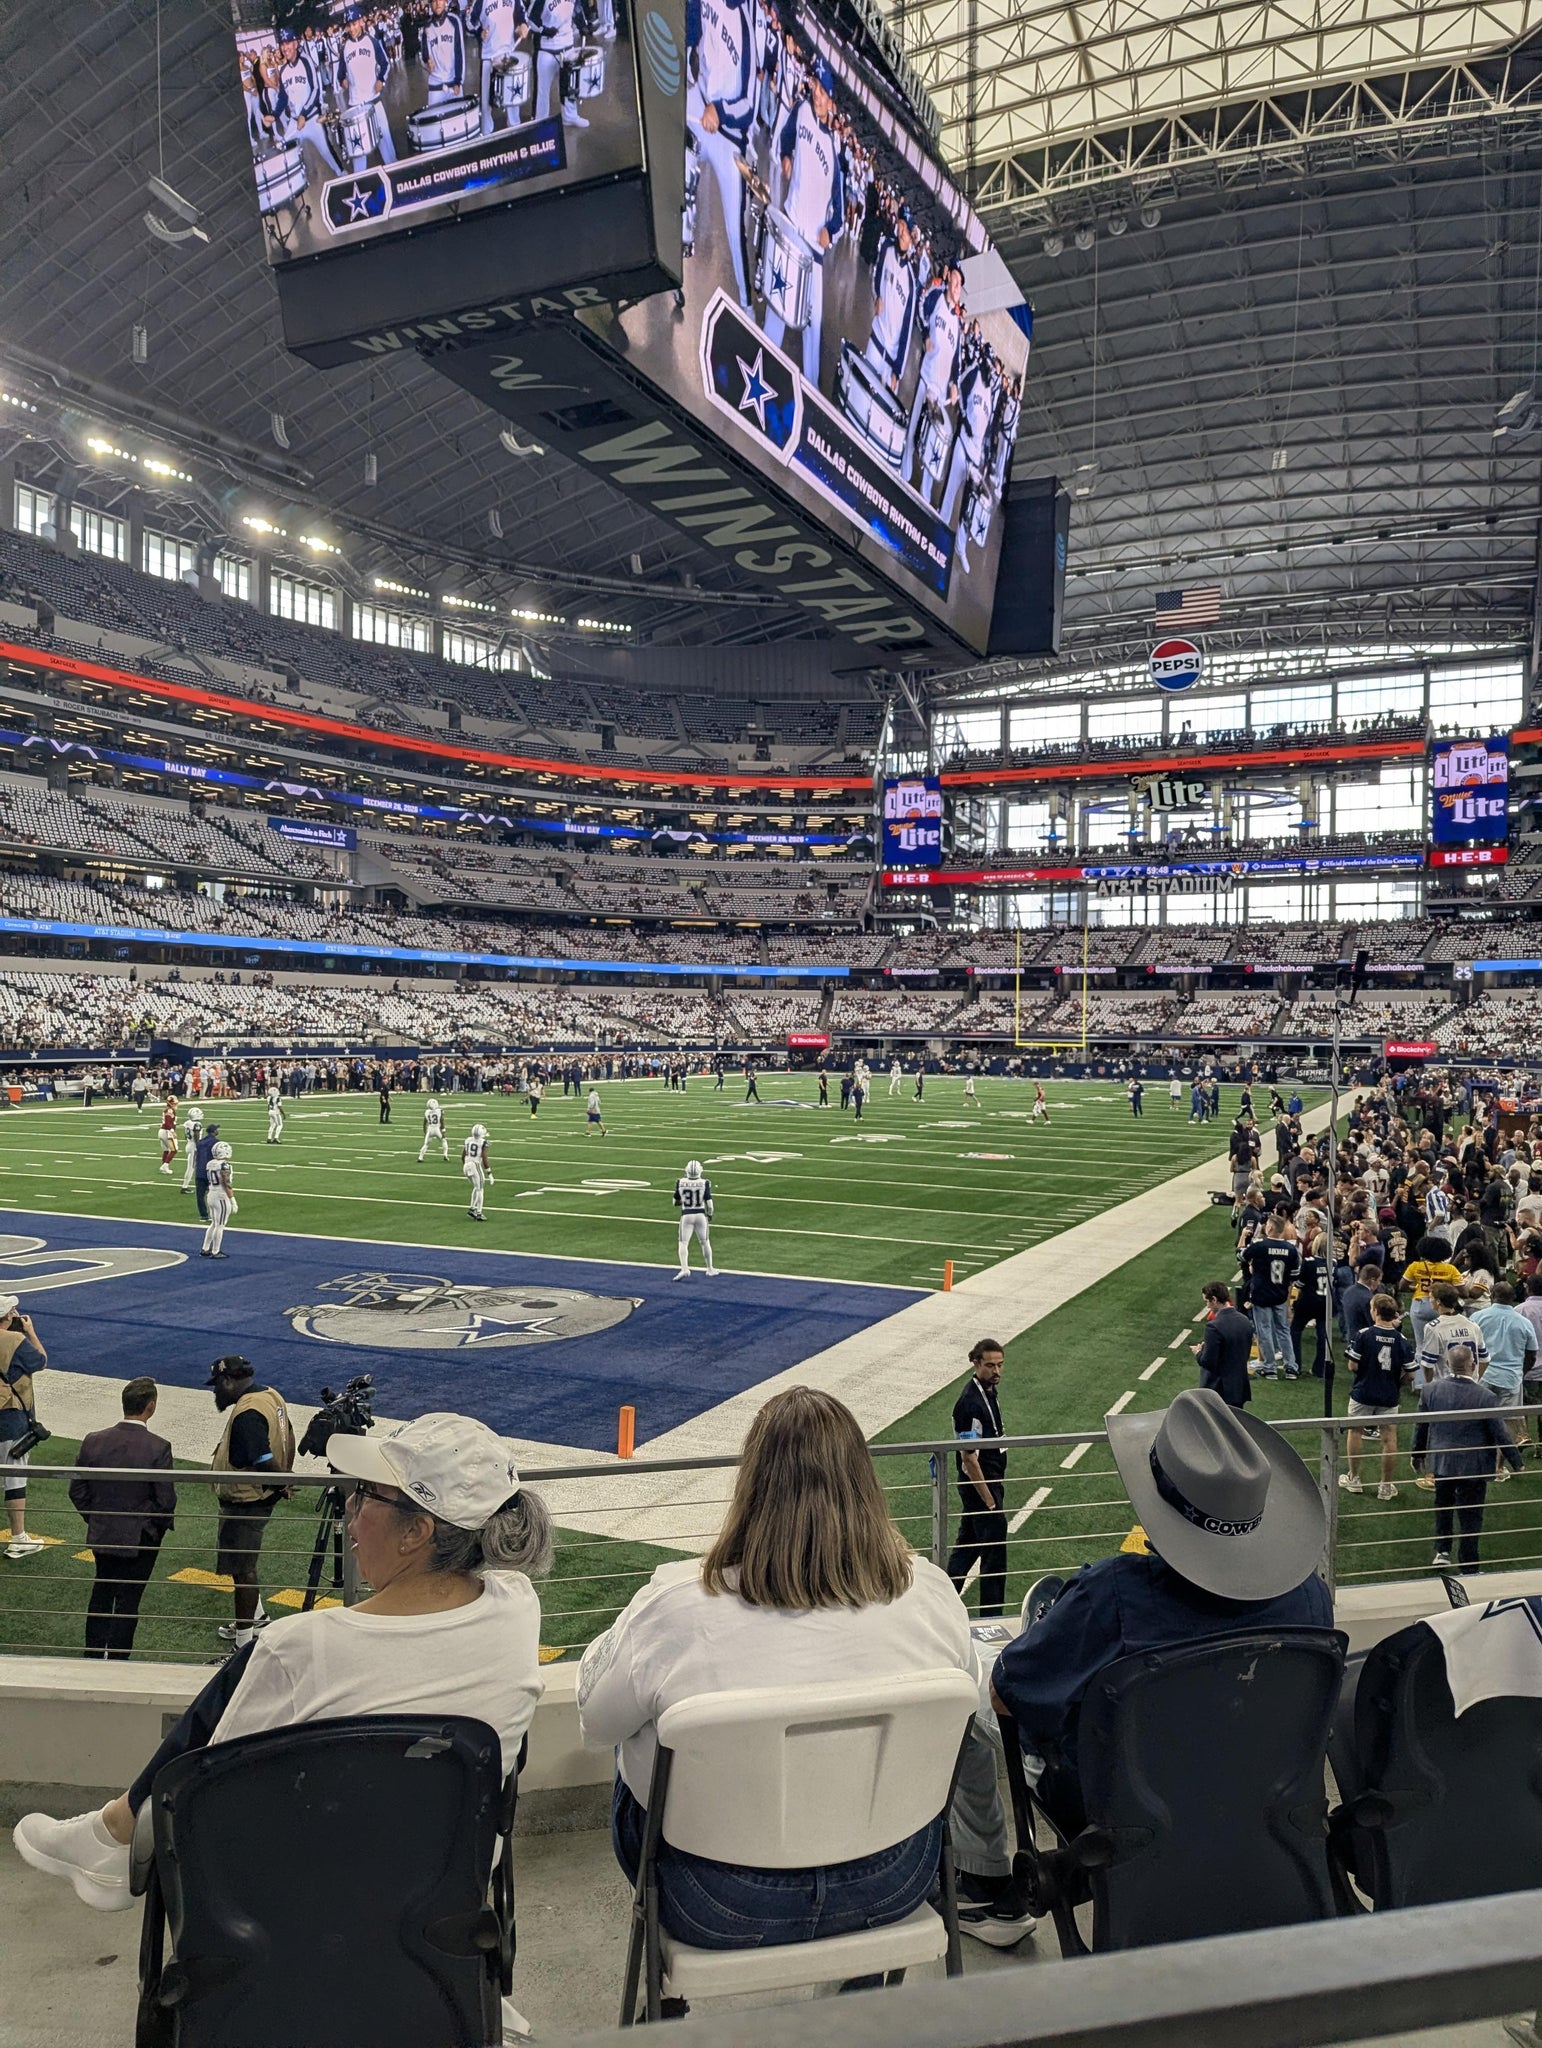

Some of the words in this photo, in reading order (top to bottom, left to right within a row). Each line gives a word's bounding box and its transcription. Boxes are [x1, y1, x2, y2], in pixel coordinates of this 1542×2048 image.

[701, 2, 719, 29] COW
[721, 24, 740, 67] BOYS
[358, 47, 371, 58] BOYS
[295, 75, 307, 85] BOYS
[798, 125, 813, 145] COW
[397, 175, 432, 194] DALLAS
[433, 161, 479, 183] COWBOYS
[480, 150, 519, 170] RHYTHM
[520, 147, 529, 159] &
[530, 139, 556, 155] BLUE
[351, 286, 608, 353] WINSTAR
[807, 427, 846, 475] DALLAS
[847, 465, 889, 515] COWBOYS
[889, 506, 921, 546] RHYTHM
[920, 535, 928, 551] &
[927, 541, 948, 569] BLUE
[578, 420, 926, 644] WINSTAR
[1152, 658, 1200, 673] PEPSI
[63, 701, 86, 713] ROGER
[86, 707, 119, 720] STAUBACH
[164, 762, 189, 775] RALLY
[191, 766, 207, 778] DAY
[1456, 755, 1487, 774] Lite
[363, 797, 393, 809] DECEMBER
[902, 791, 926, 807] Lite
[1148, 780, 1205, 812] Lite
[1439, 790, 1474, 809] Miller
[1451, 797, 1505, 824] Lite
[280, 824, 314, 837] Abercrombie
[318, 829, 333, 839] Fitch
[564, 823, 586, 833] RALLY
[586, 826, 600, 835] DAY
[746, 834, 778, 843] DECEMBER
[898, 827, 940, 851] Lite
[1220, 864, 1227, 873] 0
[1322, 859, 1342, 867] Official
[1342, 859, 1361, 867] Jeweler
[1393, 857, 1418, 866] Cowboys
[1146, 866, 1169, 875] 59:48
[1098, 878, 1143, 896] AT&T
[1147, 876, 1233, 895] STADIUM
[39, 923, 52, 931] AT&T
[94, 926, 109, 936] AT&T
[110, 928, 136, 938] STADIUM
[891, 966, 940, 976] Blockchain.com
[1155, 965, 1213, 974] Blockchain.com
[1254, 964, 1314, 973] Blockchain.com
[1455, 966, 1473, 980] 25
[427, 1114, 439, 1126] 13
[465, 1142, 479, 1157] 19
[1371, 1179, 1387, 1193] 17
[682, 1189, 702, 1207] 31
[1270, 1260, 1286, 1285] 8
[1450, 1328, 1470, 1338] LAMB
[1377, 1345, 1392, 1371] 4
